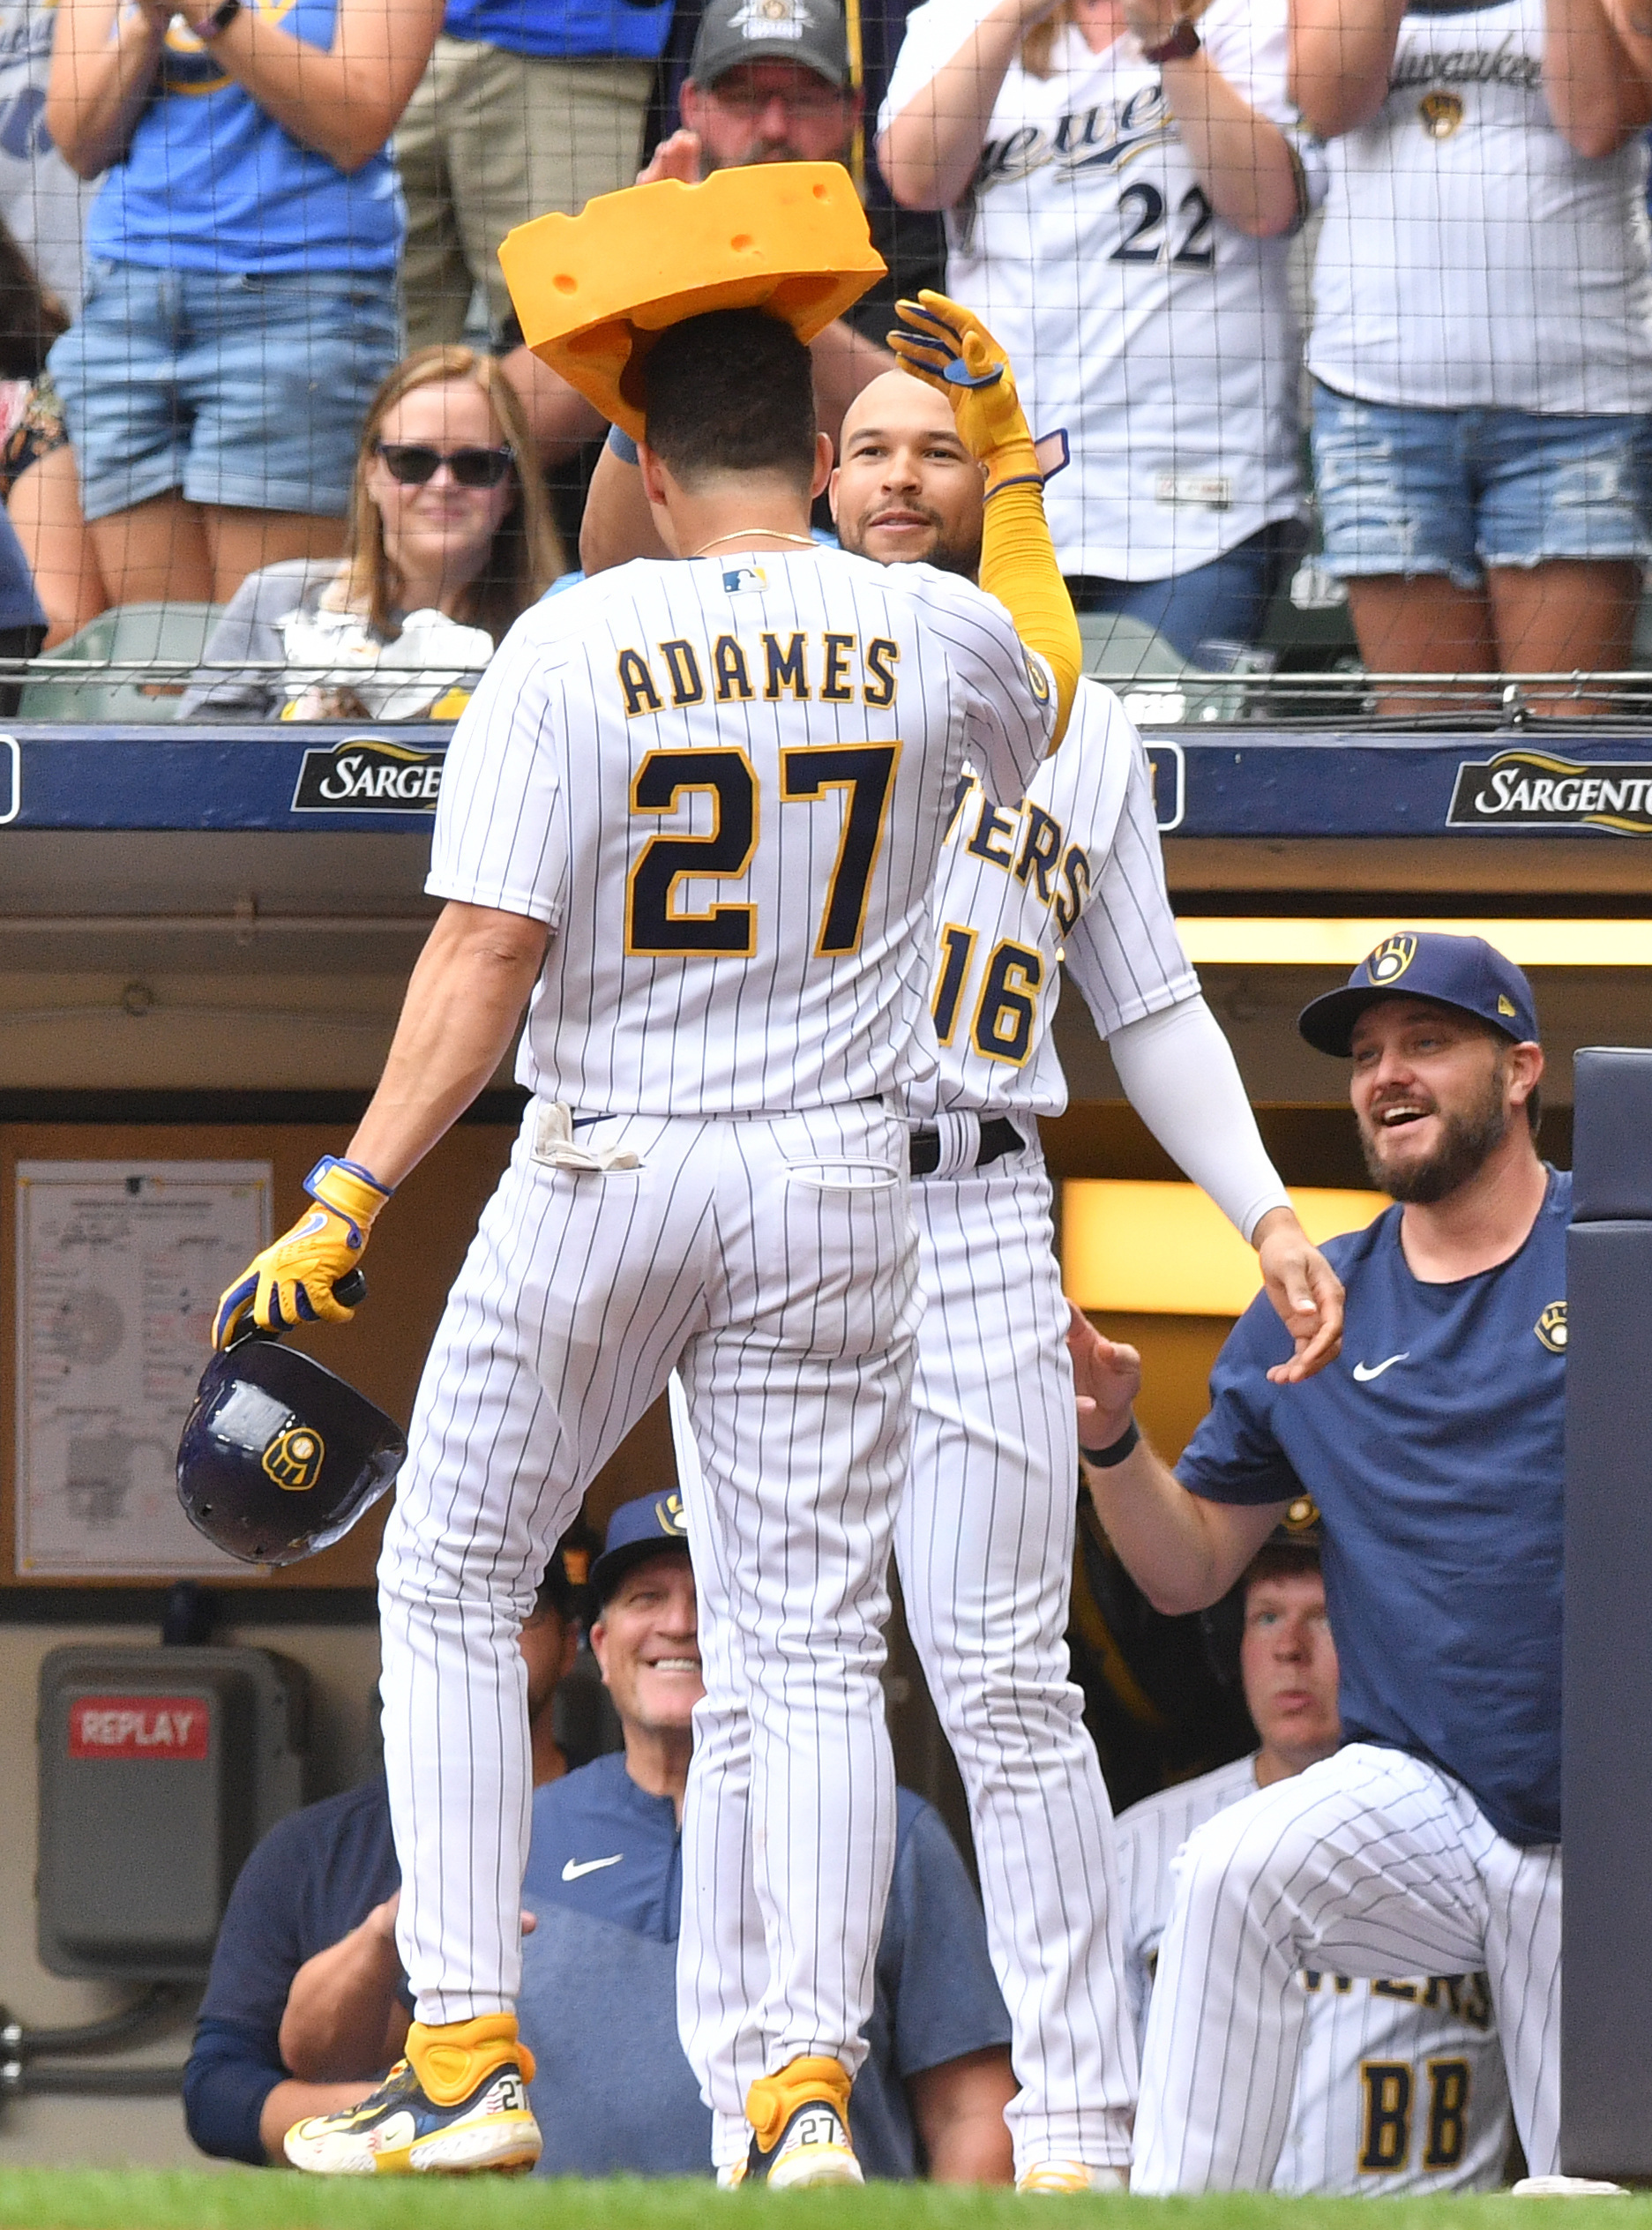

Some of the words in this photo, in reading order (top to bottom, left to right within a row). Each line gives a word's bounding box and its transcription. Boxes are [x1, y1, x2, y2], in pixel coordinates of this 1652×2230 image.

[1109, 183, 1215, 273] 22
[616, 630, 901, 719] ADAMES
[1475, 768, 1652, 816] SARGENT
[624, 739, 903, 959] 27
[931, 922, 1044, 1069] 16
[81, 1710, 194, 1747] REPLAY
[799, 2117, 834, 2146] 27
